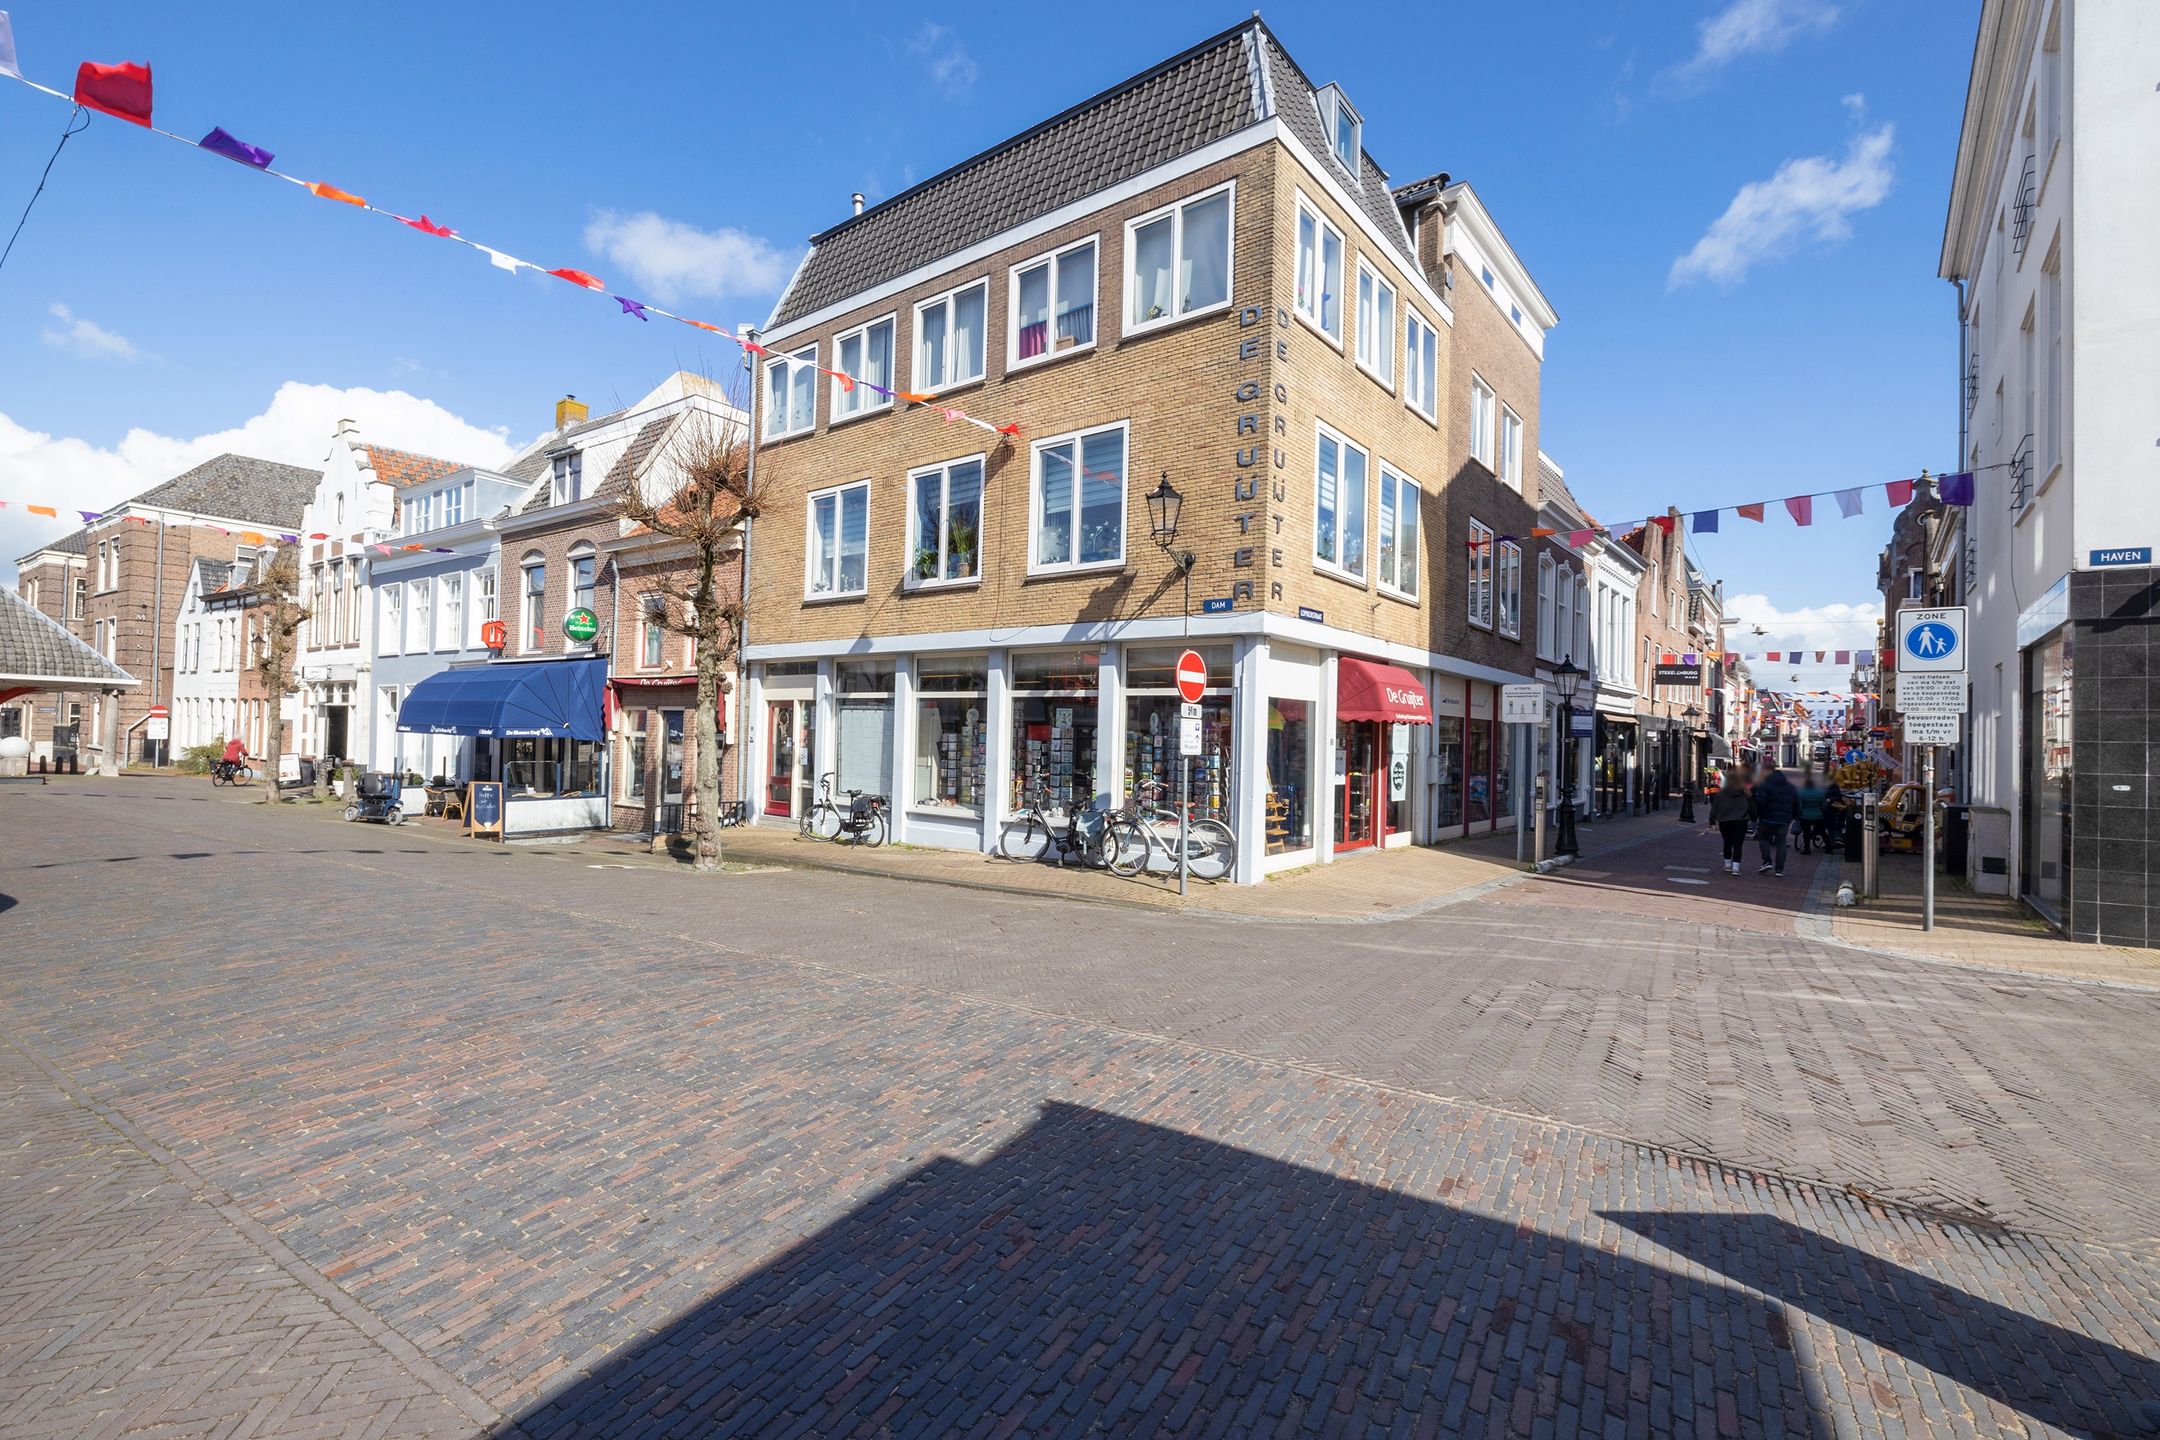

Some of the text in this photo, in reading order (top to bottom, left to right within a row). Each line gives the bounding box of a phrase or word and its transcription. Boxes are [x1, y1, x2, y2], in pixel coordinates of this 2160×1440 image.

[2100, 551, 2141, 562] HAVEN
[1211, 601, 1226, 610] DAM
[1917, 612, 1947, 620] ZONE
[1386, 687, 1399, 703] De
